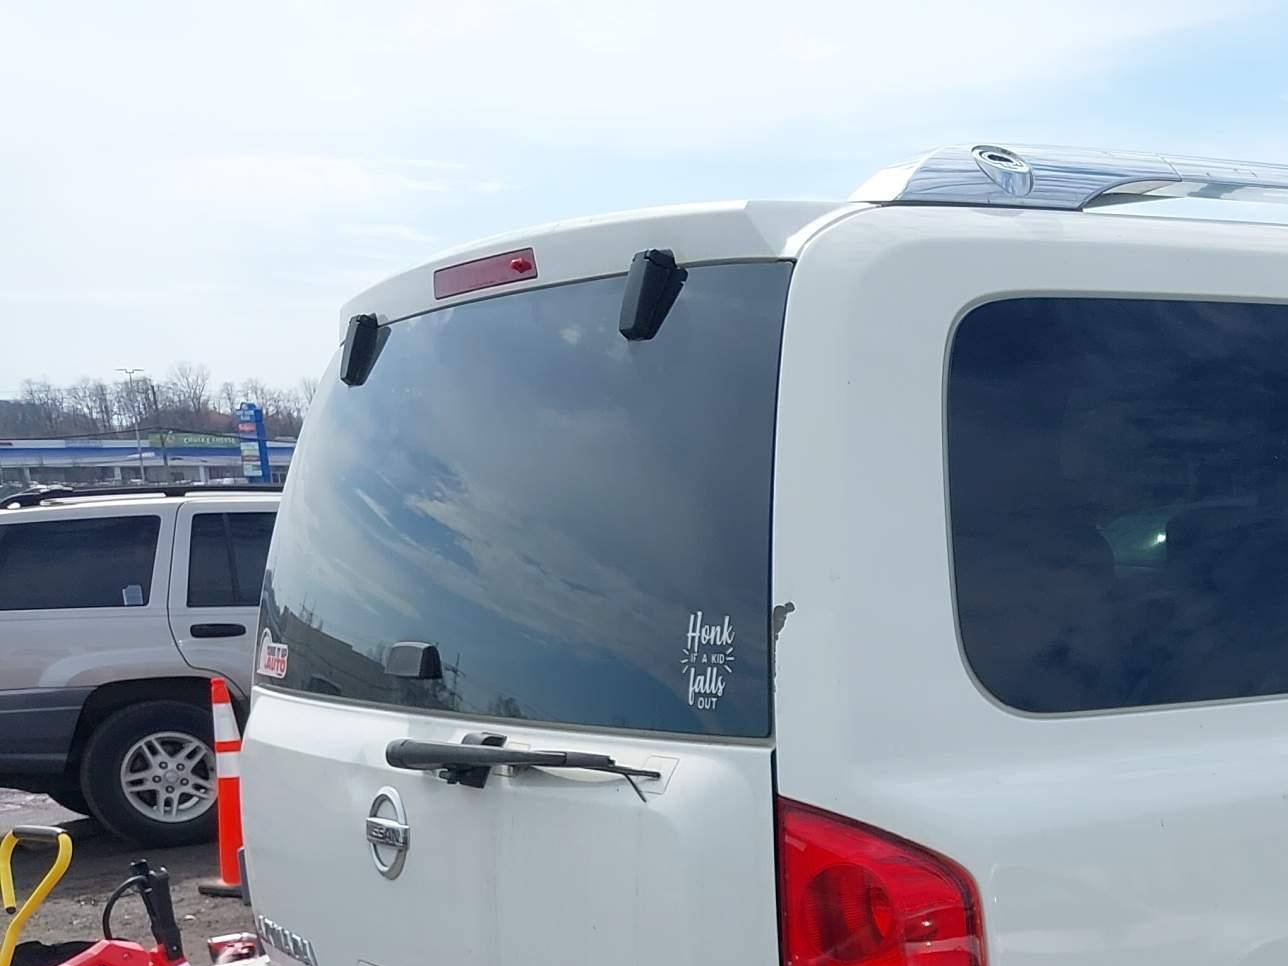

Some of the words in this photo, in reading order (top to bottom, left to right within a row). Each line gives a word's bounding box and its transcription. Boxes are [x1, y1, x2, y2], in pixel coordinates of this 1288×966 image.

[686, 610, 735, 653] Honk
[701, 653, 708, 664] A
[711, 653, 725, 664] KID
[688, 666, 726, 706] falls
[697, 697, 718, 710] OUT
